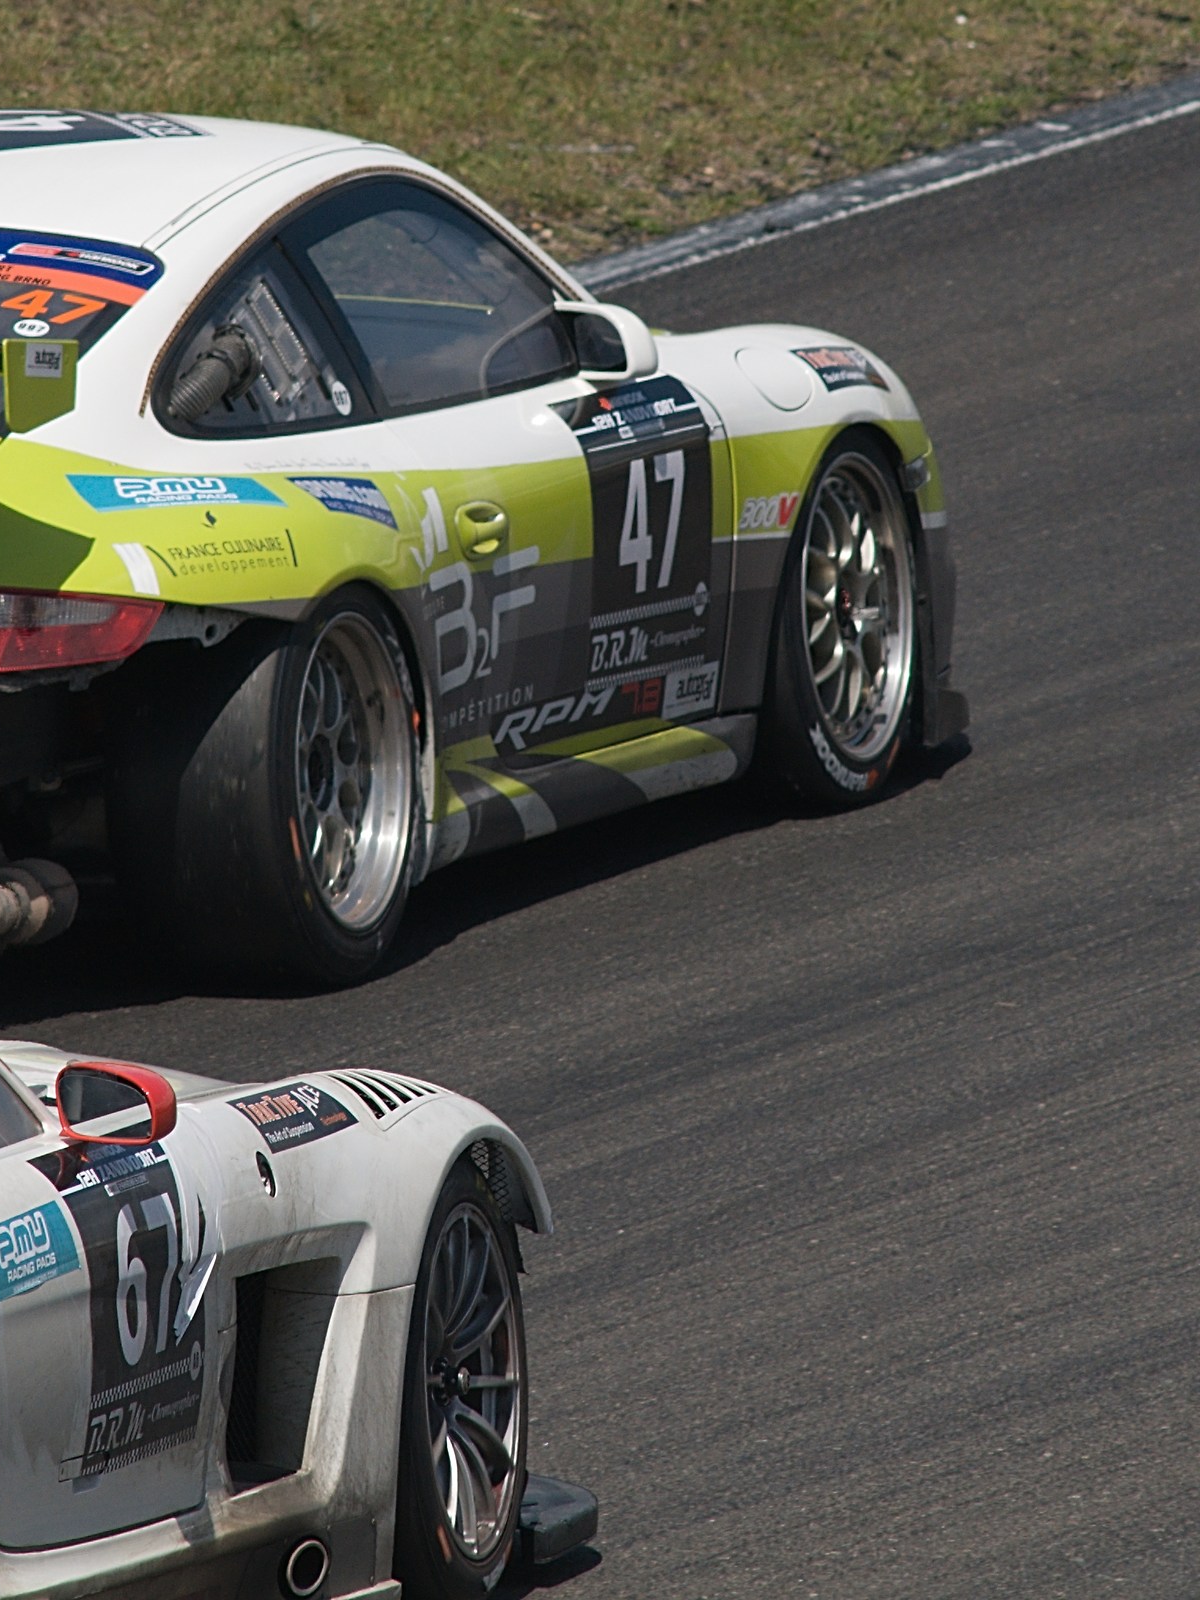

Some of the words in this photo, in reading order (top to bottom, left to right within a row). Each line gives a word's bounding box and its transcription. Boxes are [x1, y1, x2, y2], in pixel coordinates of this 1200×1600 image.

[13, 275, 51, 286] BRNO
[0, 289, 106, 325] 47
[134, 494, 193, 504] RACING
[196, 492, 238, 501] PADS
[739, 491, 800, 529] 300V
[619, 449, 686, 595] 47
[168, 542, 222, 561] FRANCE
[222, 536, 286, 555] CULINAIRE
[494, 685, 615, 750] RPM
[290, 1085, 320, 1117] ACE
[75, 1168, 101, 1189] 12H
[96, 1148, 158, 1183] ZANDVOORT
[7, 1260, 35, 1284] RACING
[36, 1252, 57, 1271] PADS
[116, 1191, 180, 1367] 67
